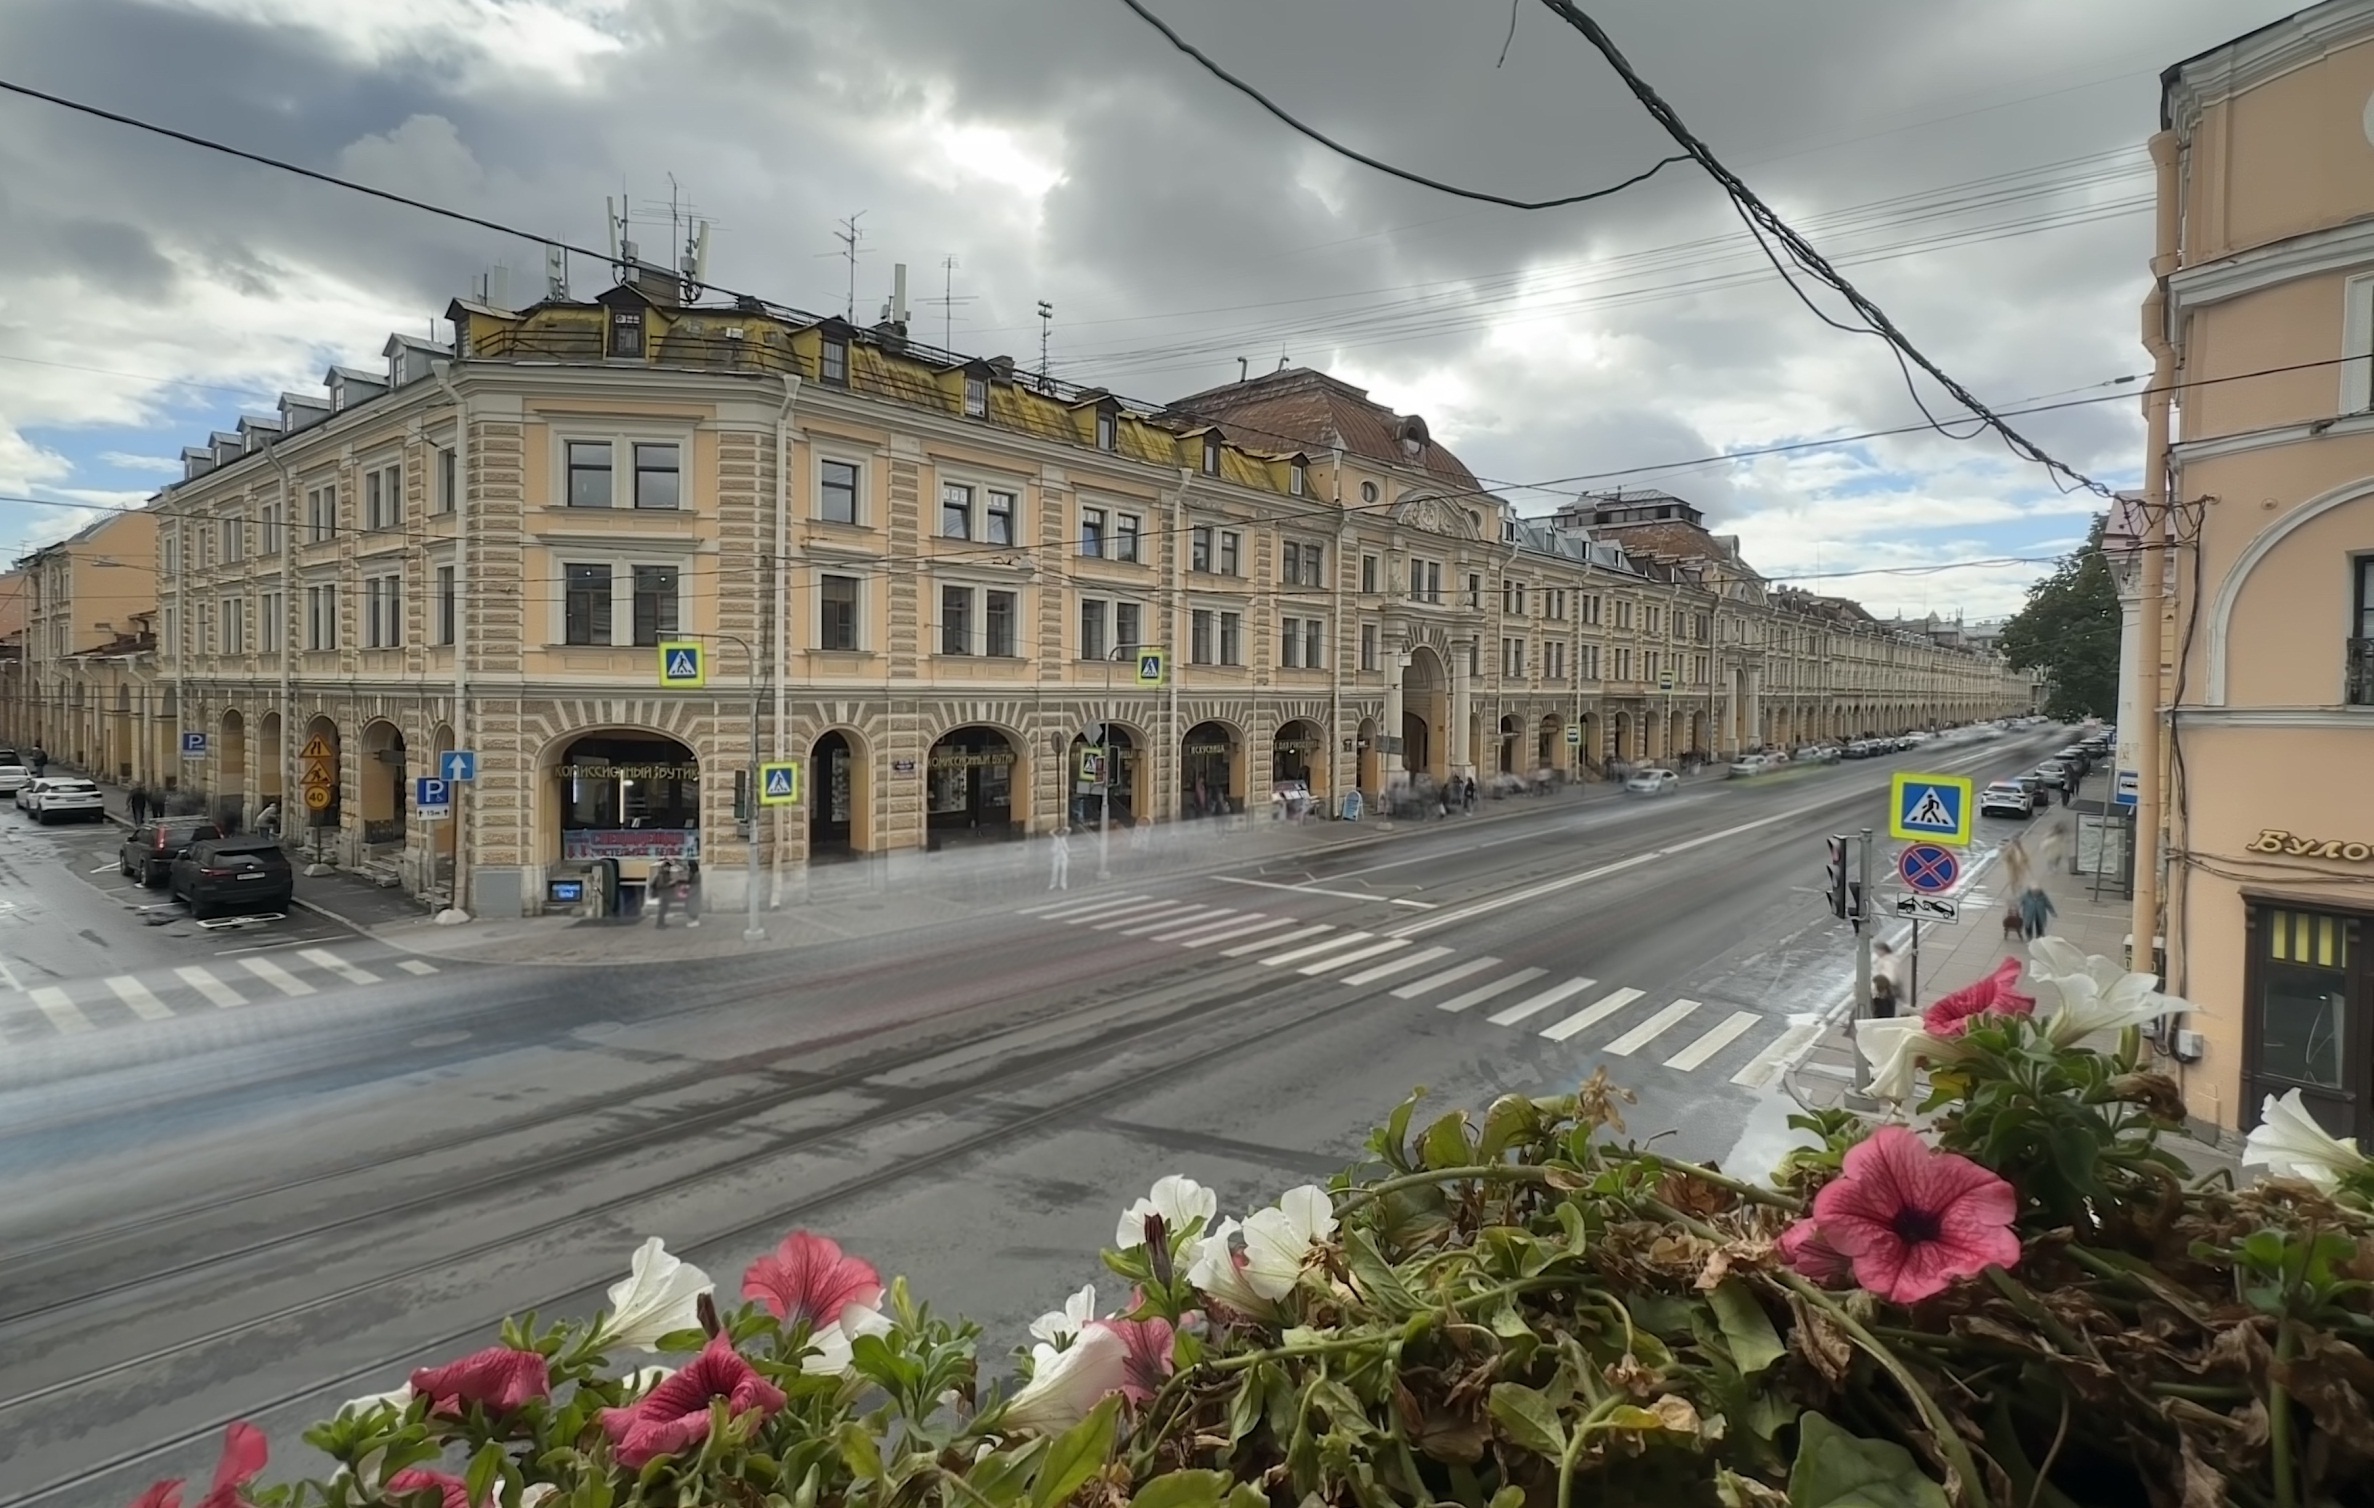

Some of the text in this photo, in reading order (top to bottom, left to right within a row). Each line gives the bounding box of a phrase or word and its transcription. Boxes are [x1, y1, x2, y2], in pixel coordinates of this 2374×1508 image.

[554, 765, 699, 780] КОМИССИОННЫЙ БУТИК
[308, 792, 324, 802] 40
